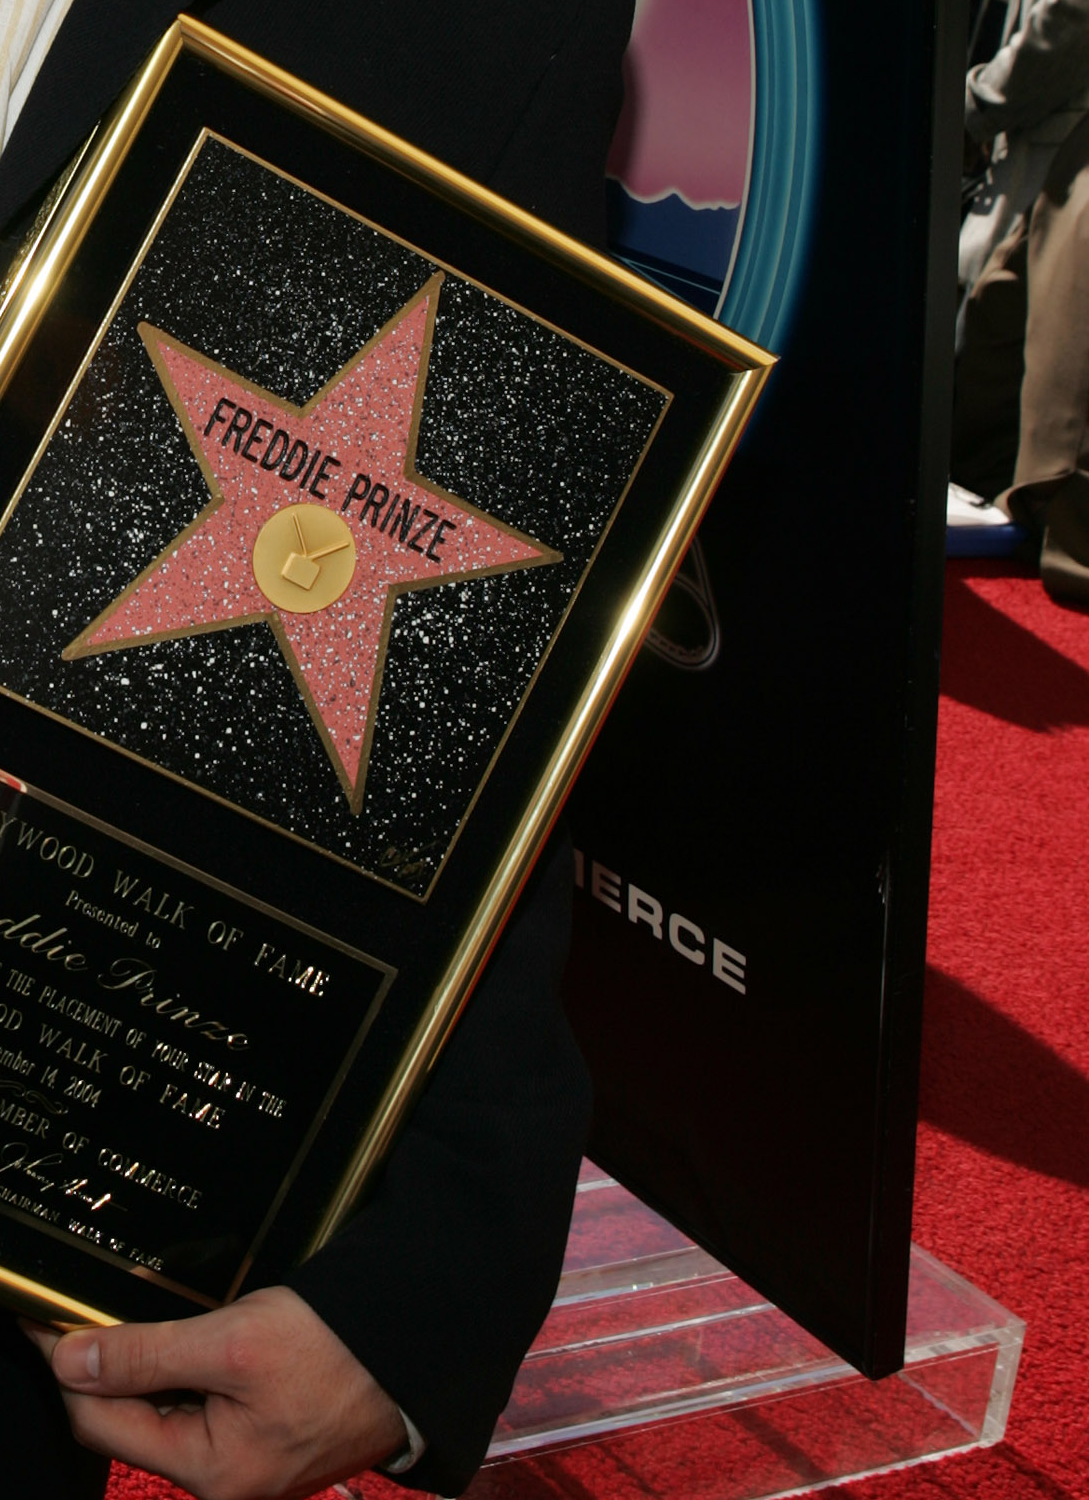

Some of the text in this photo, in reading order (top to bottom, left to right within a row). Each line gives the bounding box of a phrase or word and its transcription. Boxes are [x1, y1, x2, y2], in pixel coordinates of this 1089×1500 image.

[203, 397, 457, 563] FREDDIE PRINZE
[65, 890, 161, 949] Presented to
[113, 869, 195, 930] WALK
[207, 920, 244, 950] OF
[254, 943, 330, 996] FAME
[574, 848, 747, 995] ERCE
[6, 968, 36, 997] THE
[38, 985, 123, 1038] PLACEMENT
[126, 1028, 147, 1049] OF
[151, 1042, 189, 1072] YOUR
[193, 1061, 231, 1092] STAR
[235, 1081, 256, 1103] IN
[258, 1091, 287, 1117] THE
[97, 958, 251, 1051] Prinze
[38, 1023, 108, 1073] WALK
[119, 1065, 150, 1091] OF
[159, 1083, 226, 1129] FAME
[63, 1076, 102, 1108] 2004
[62, 1131, 89, 1154] OF
[97, 1148, 203, 1210] COMMERCE
[68, 1218, 103, 1244] WALK
[110, 1238, 126, 1253] OF
[128, 1248, 165, 1271] FAME
